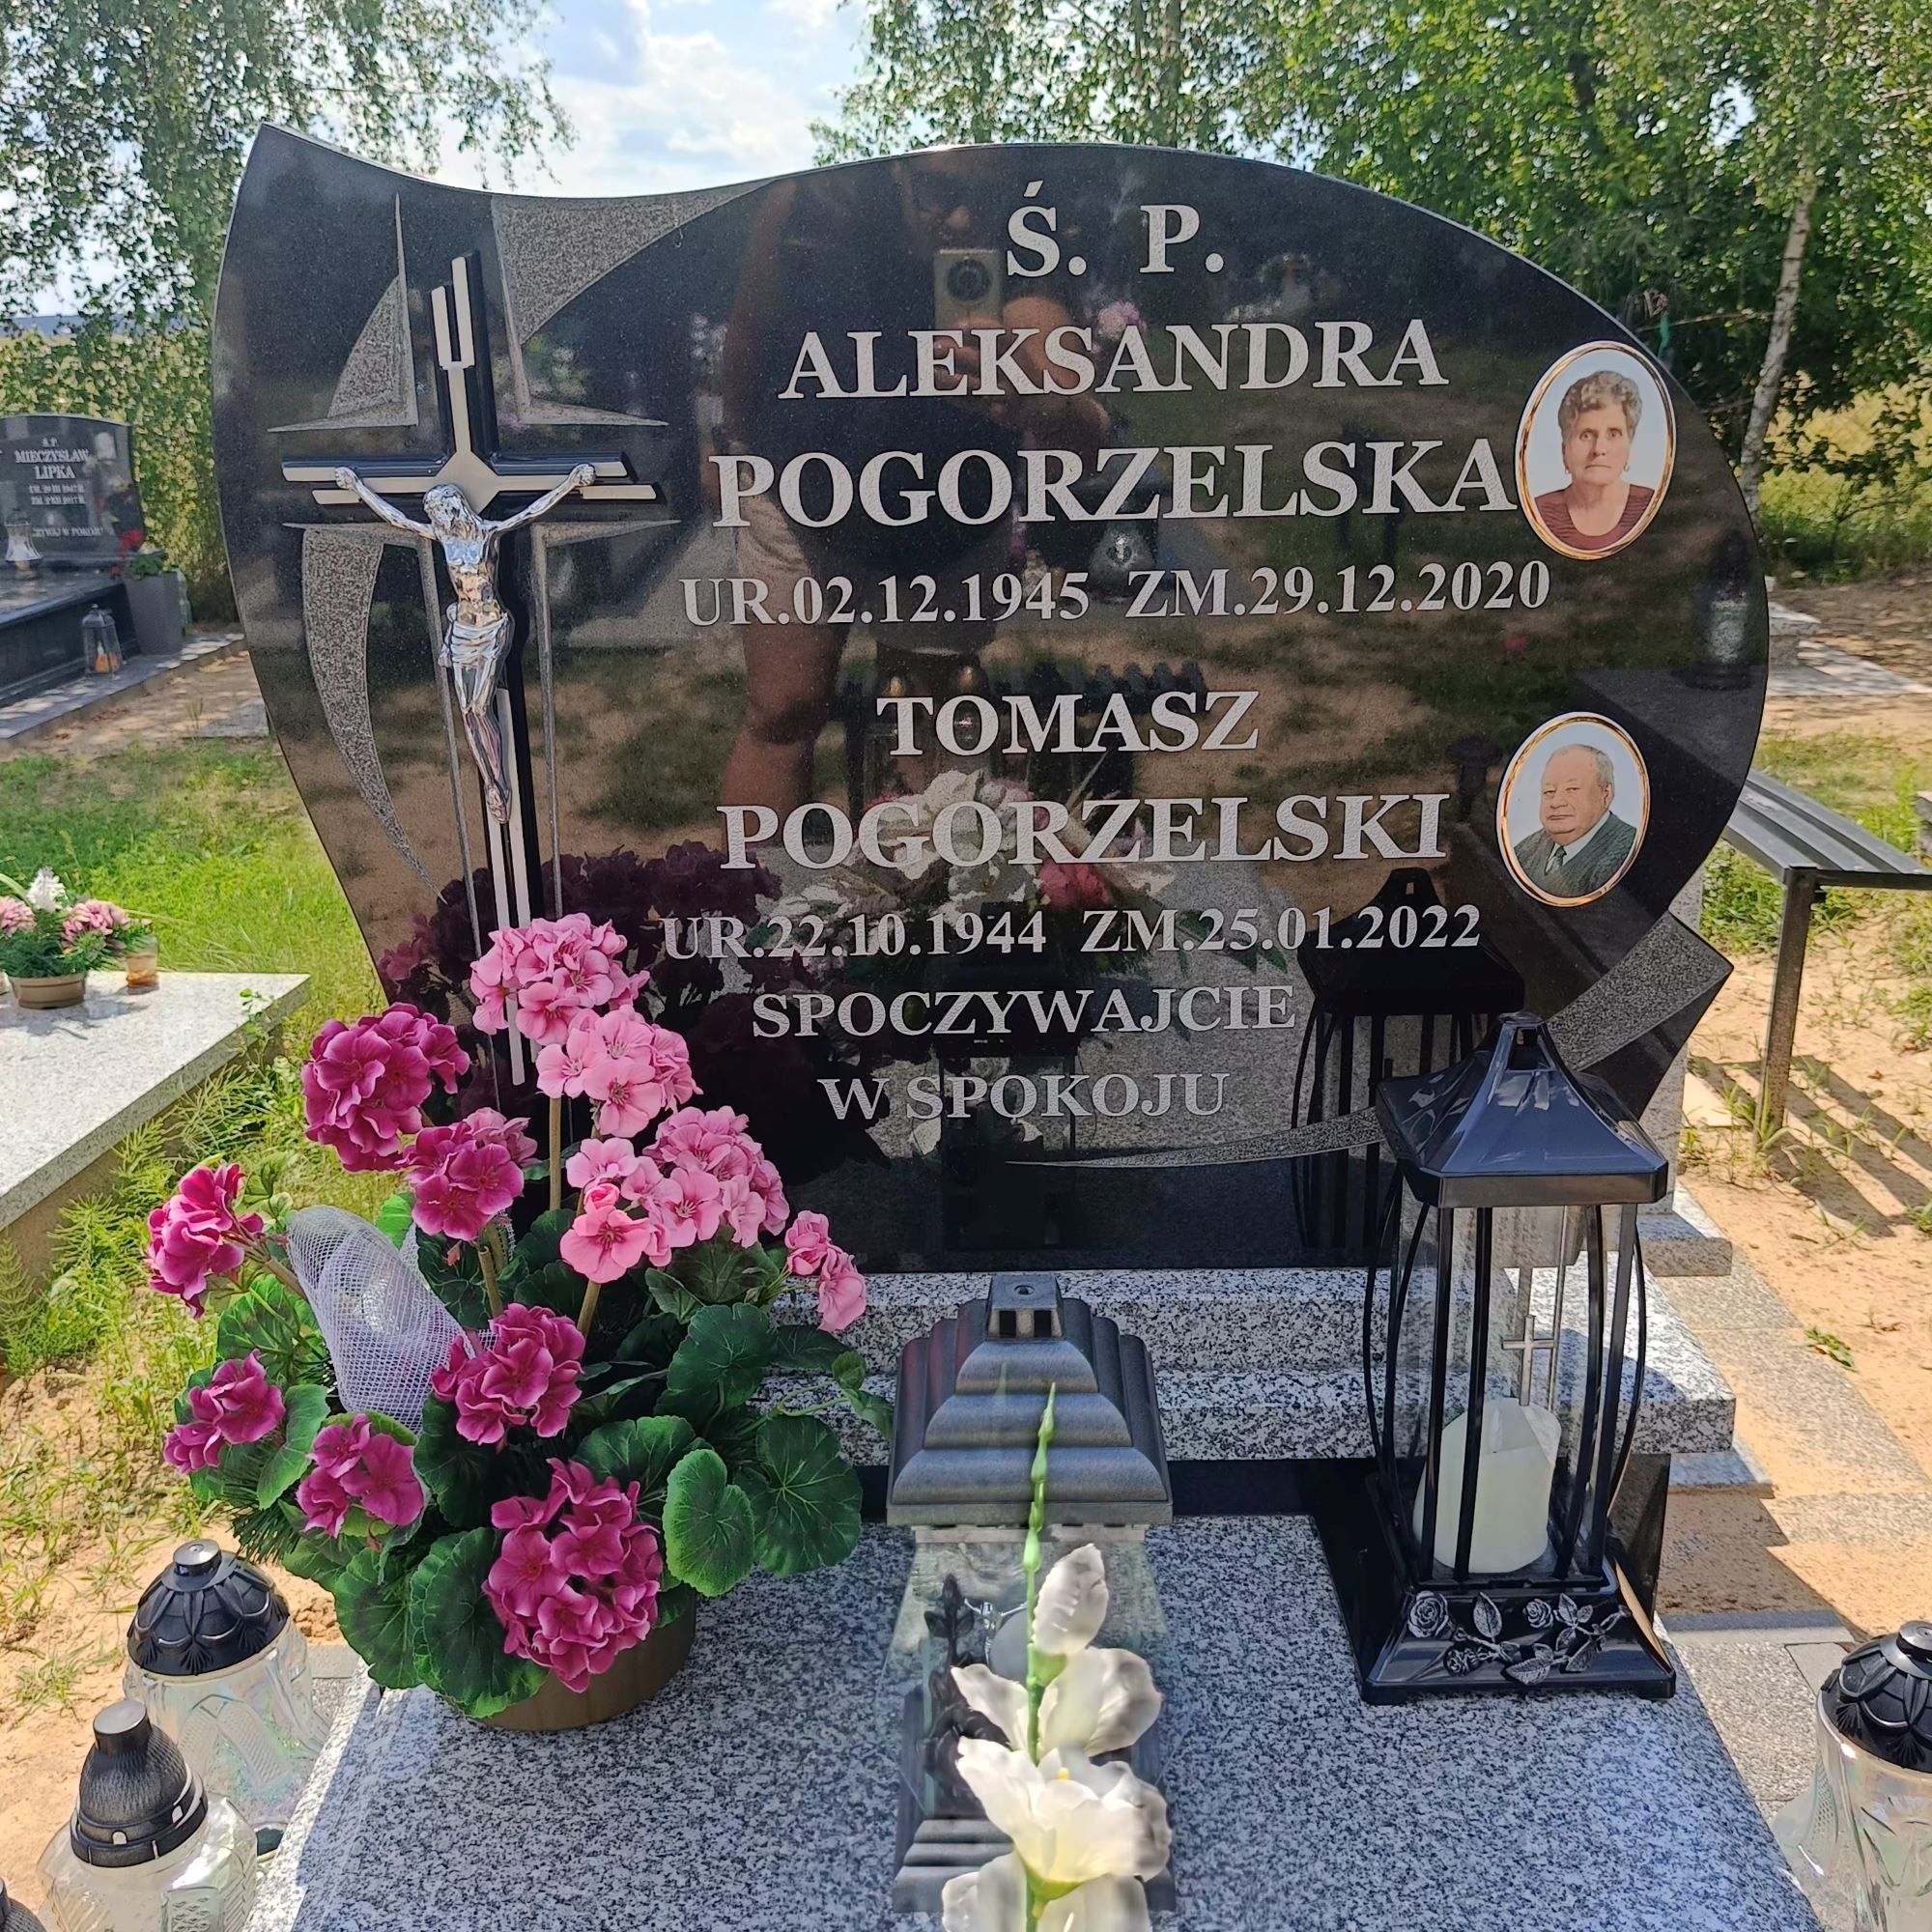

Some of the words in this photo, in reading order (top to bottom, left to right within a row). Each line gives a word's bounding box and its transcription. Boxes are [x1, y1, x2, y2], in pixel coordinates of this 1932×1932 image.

[1006, 181, 1087, 277] Ś.
[1139, 204, 1225, 274] P.
[778, 319, 1448, 400] ALEKSANDRA
[34, 465, 76, 480] LIPKA
[710, 439, 1518, 528] POGORZELSKA
[680, 571, 1090, 627] UR.02.12.1945
[1125, 560, 1550, 618] ZM.29.12.2020
[876, 691, 1259, 757] TOMASZ
[717, 793, 1450, 870] POGORZELSKI
[663, 910, 1046, 960] UR.22.10.1944
[1081, 904, 1481, 953] ZM.25.01.2022
[752, 985, 1296, 1038] SPOCZYWAJCIE
[817, 1077, 889, 1121] W
[905, 1073, 1230, 1121] SPOKOJU
